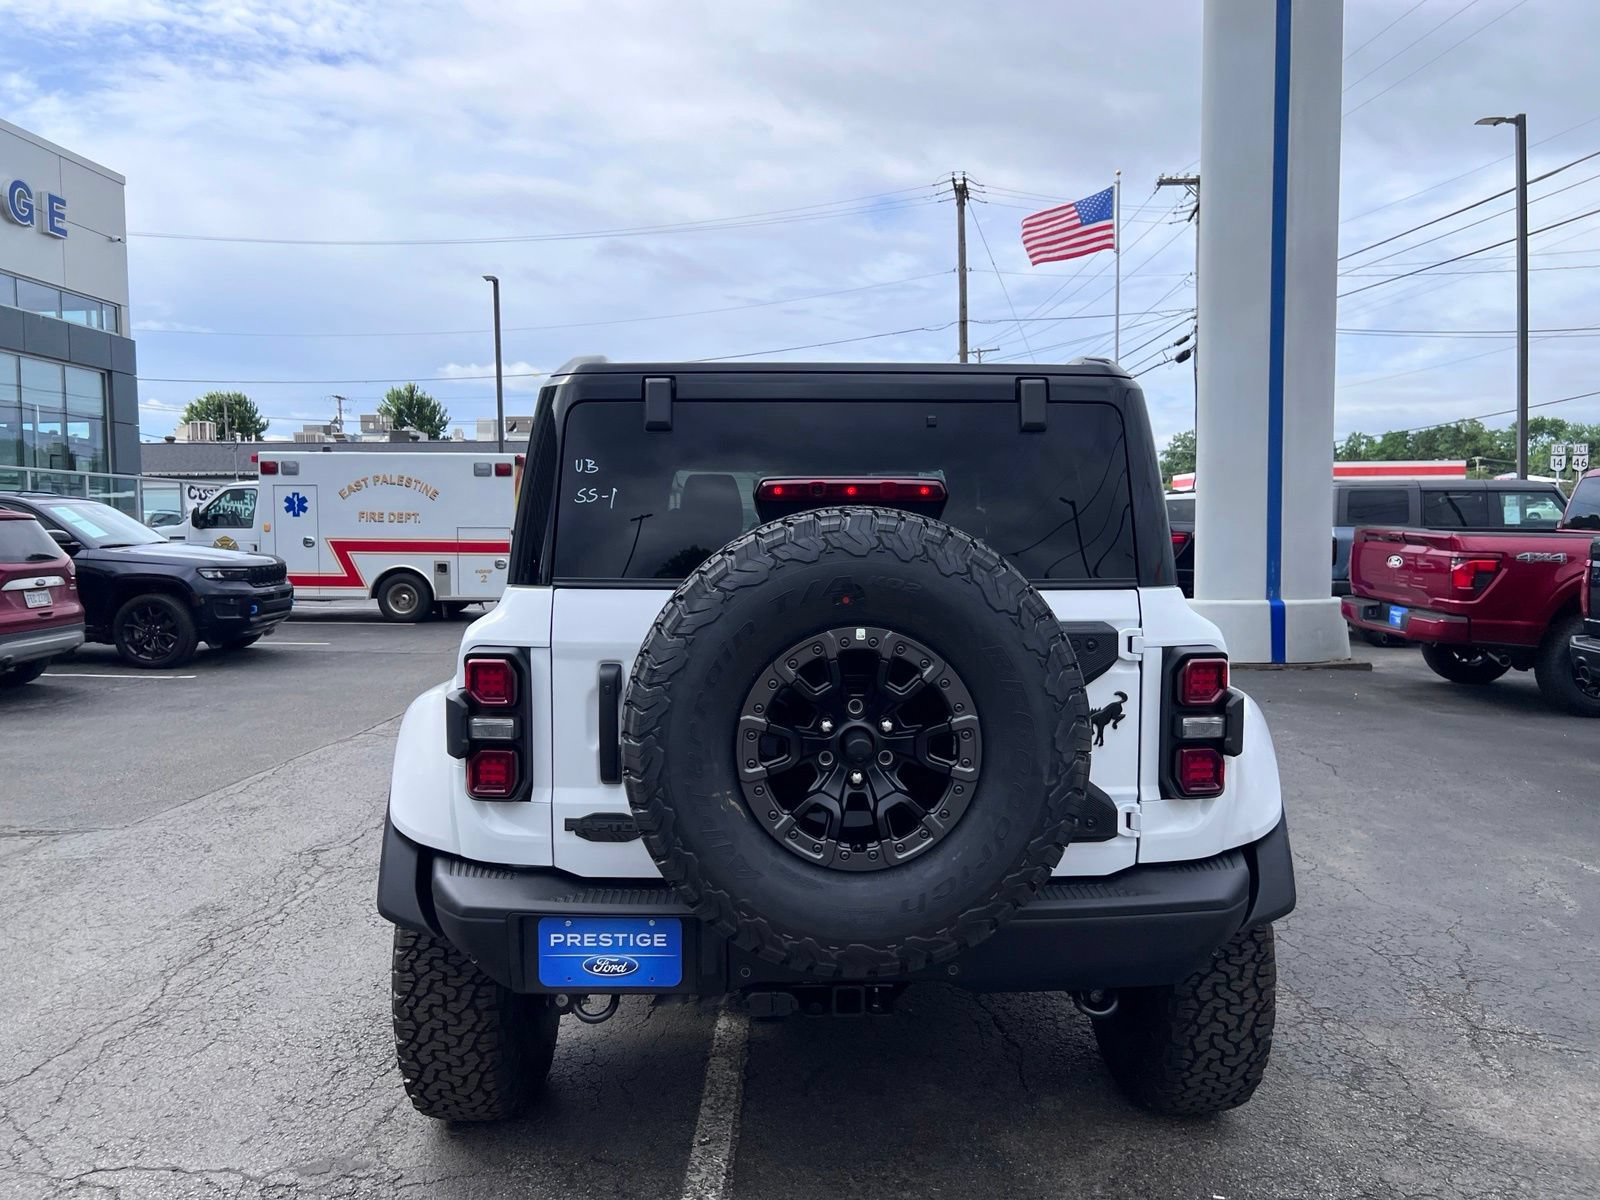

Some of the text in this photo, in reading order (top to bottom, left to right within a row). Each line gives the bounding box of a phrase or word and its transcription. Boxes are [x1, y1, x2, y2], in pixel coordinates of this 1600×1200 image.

[1552, 445, 1565, 453] JCT
[1574, 445, 1587, 453] JCT
[575, 458, 599, 473] UB
[1552, 458, 1563, 468] 14
[1573, 458, 1588, 468] 46
[338, 474, 440, 501] EAST PALESTINE
[188, 485, 256, 506] CUSOER
[358, 511, 421, 524] FIRE DEPT.
[480, 574, 488, 583] 2
[550, 933, 667, 947] PRESTIGE
[592, 957, 628, 973] Ford
